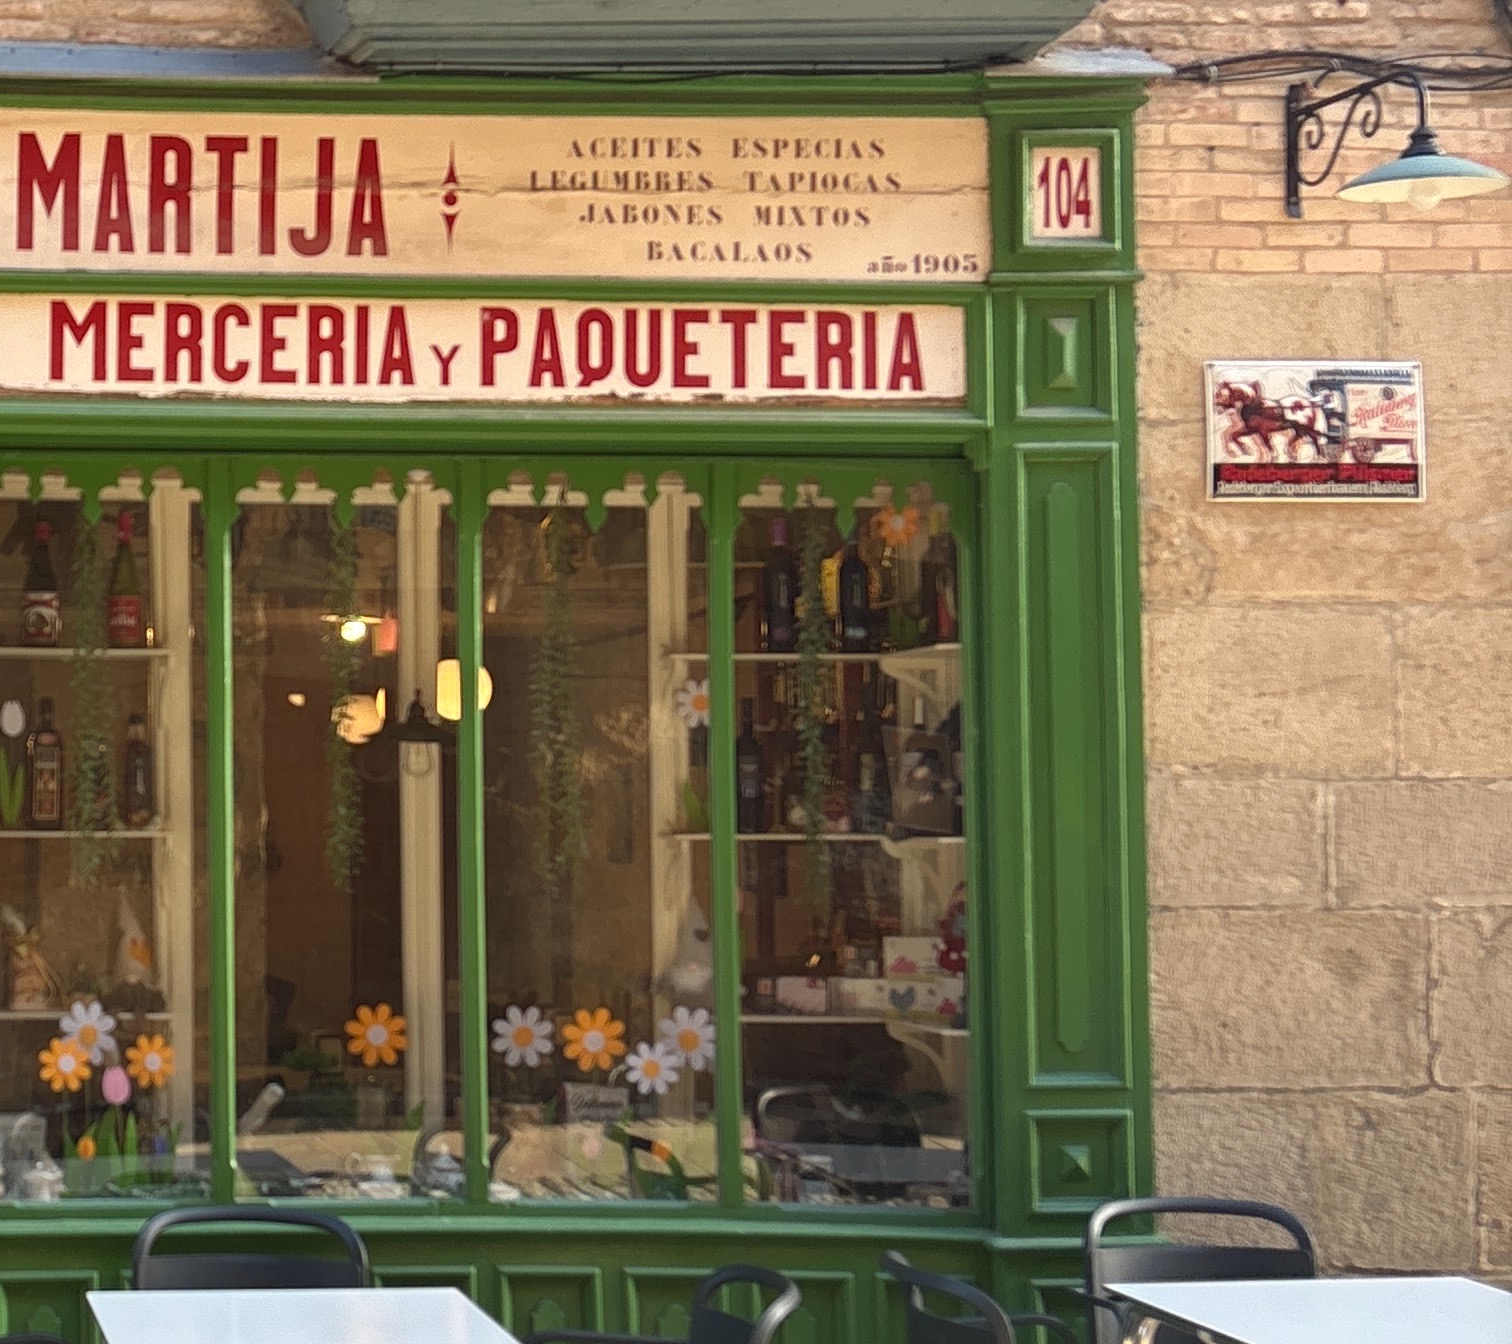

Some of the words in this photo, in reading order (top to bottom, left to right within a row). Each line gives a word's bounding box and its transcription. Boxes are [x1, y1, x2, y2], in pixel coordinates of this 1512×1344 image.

[568, 137, 702, 159] ACEITES
[733, 138, 884, 159] ESPECIAS
[529, 170, 714, 193] LEGUMBRES
[749, 172, 900, 193] TAPIOCAS
[1039, 157, 1091, 228] 104
[18, 132, 387, 256] MARTIJA
[580, 204, 722, 224] JABONES
[756, 206, 869, 226] MIXTOS
[648, 241, 811, 262] BACALAOS
[912, 253, 979, 274] 1905
[49, 300, 415, 386] MERCERIA
[432, 345, 459, 385] Y
[480, 306, 925, 392] PAQUETERIA
